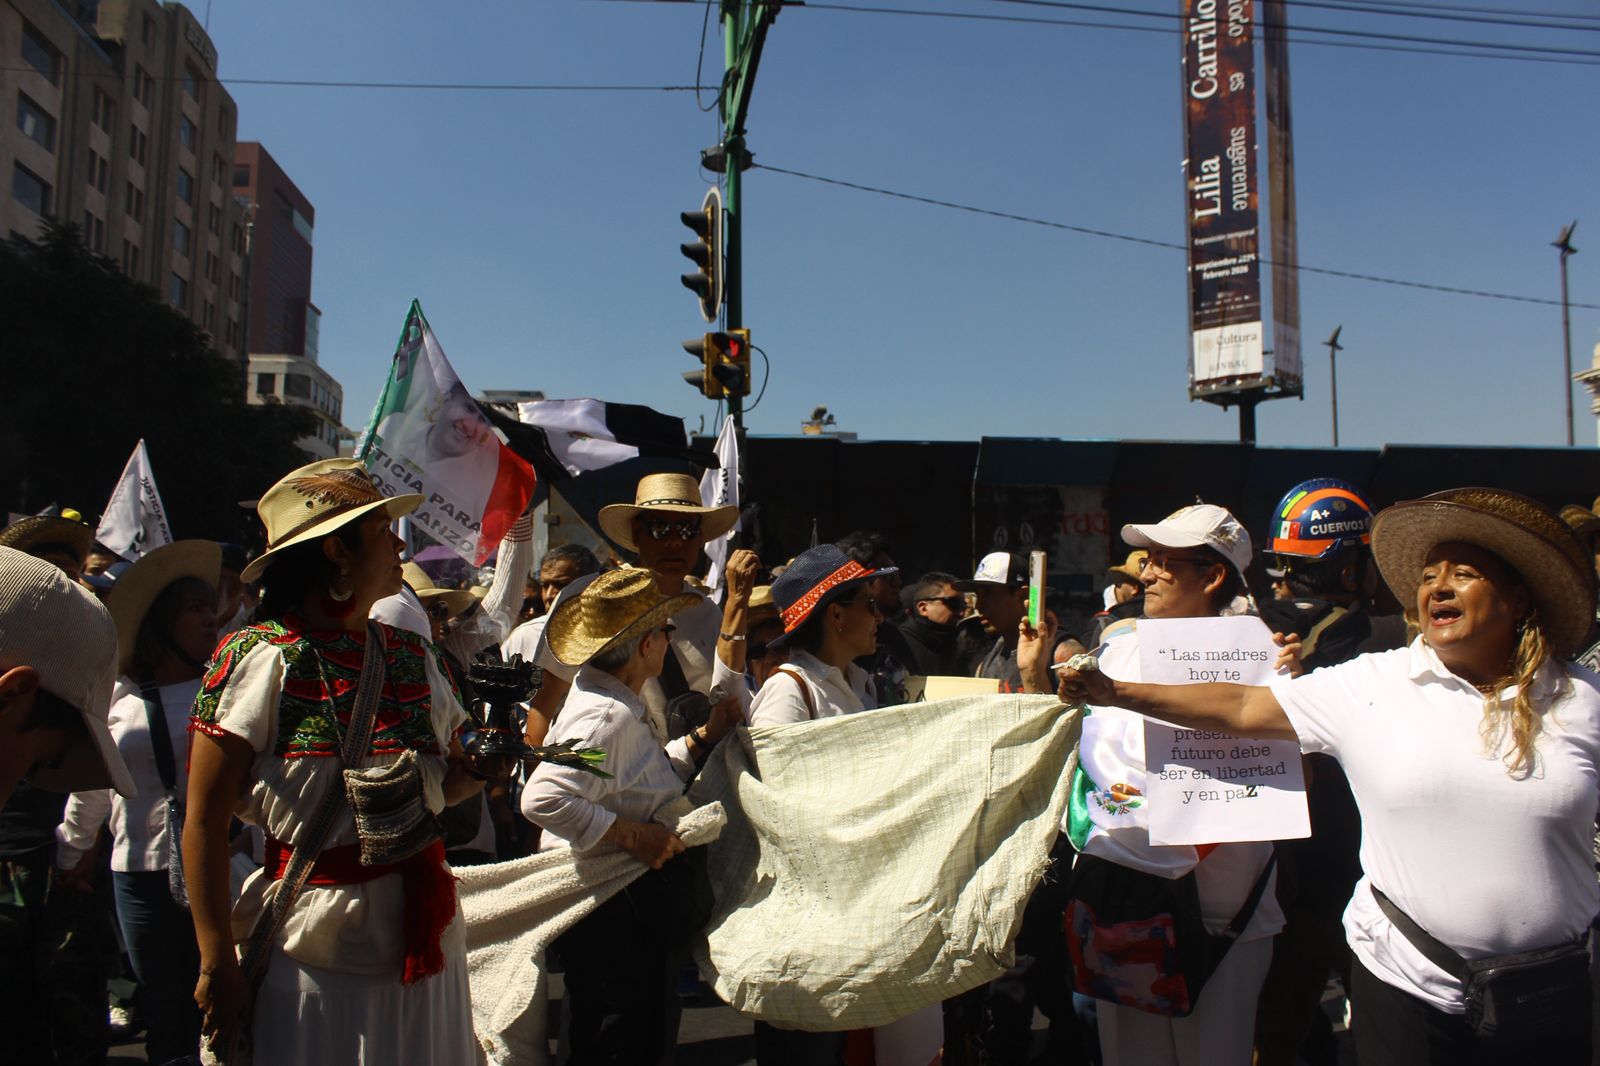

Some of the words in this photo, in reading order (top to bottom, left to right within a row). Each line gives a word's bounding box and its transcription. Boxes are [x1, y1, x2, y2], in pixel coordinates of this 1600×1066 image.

[1229, 72, 1245, 92] es
[1227, 126, 1248, 211] sugerente
[1194, 155, 1221, 219] Lilia
[1216, 333, 1257, 347] Cultura
[375, 448, 424, 494] TICIA
[428, 492, 481, 533] PARA
[142, 476, 163, 521] JUSTICIA
[159, 522, 171, 544] PAR
[370, 473, 397, 497] OS
[410, 509, 474, 552] ANZO
[1310, 509, 1330, 521] A+
[1171, 648, 1201, 661] Las
[1205, 648, 1268, 662] madres
[1189, 668, 1222, 683] hoy
[1224, 669, 1241, 681] te
[1171, 747, 1226, 760] futuro
[1230, 744, 1272, 760] debe
[1159, 769, 1186, 780] ser
[1192, 769, 1212, 780] en
[1216, 762, 1287, 780] libertad
[1182, 790, 1194, 804] y
[1198, 789, 1220, 801] en
